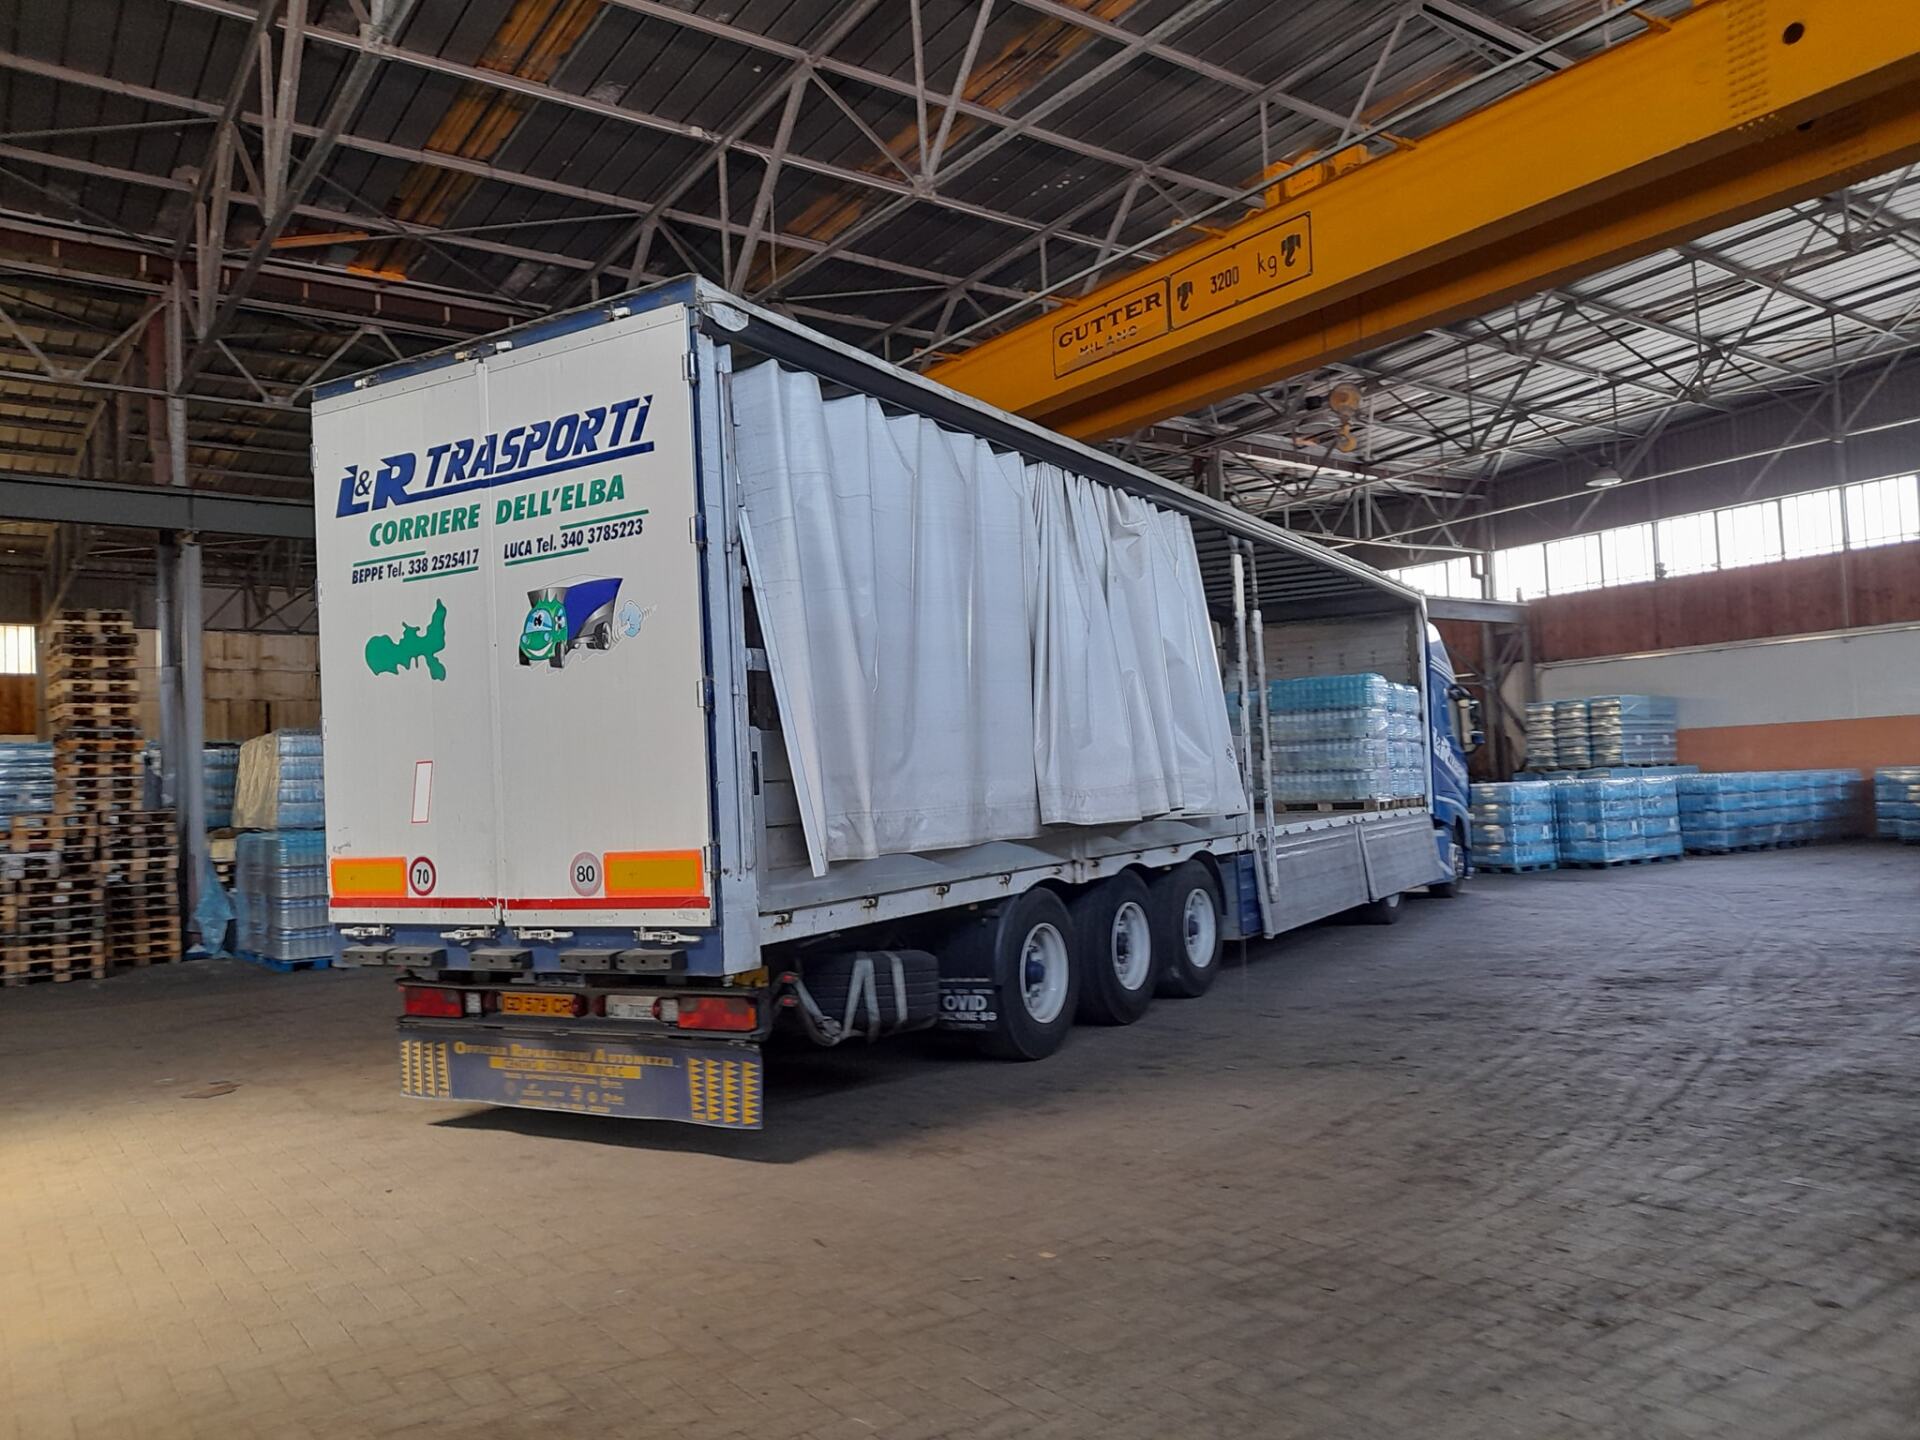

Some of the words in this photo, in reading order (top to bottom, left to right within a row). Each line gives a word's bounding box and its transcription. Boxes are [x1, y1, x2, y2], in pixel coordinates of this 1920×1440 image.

[1210, 266, 1239, 295] 3200
[1257, 253, 1277, 278] kg
[1058, 292, 1163, 348] GUTTER
[335, 452, 417, 518] L&R
[424, 394, 654, 488] TRASPORTI
[369, 503, 481, 547] CORRIERE
[495, 474, 625, 526] DELL'ELBA
[504, 540, 532, 560] LUCA
[536, 535, 557, 554] Tel.
[561, 529, 583, 549] 340
[587, 519, 643, 545] 3785223
[352, 564, 383, 585] BEPPE
[387, 560, 405, 579] Tel.
[408, 556, 428, 575] 338
[431, 548, 479, 572] 2525417
[416, 868, 429, 885] 70
[577, 864, 595, 883] 80
